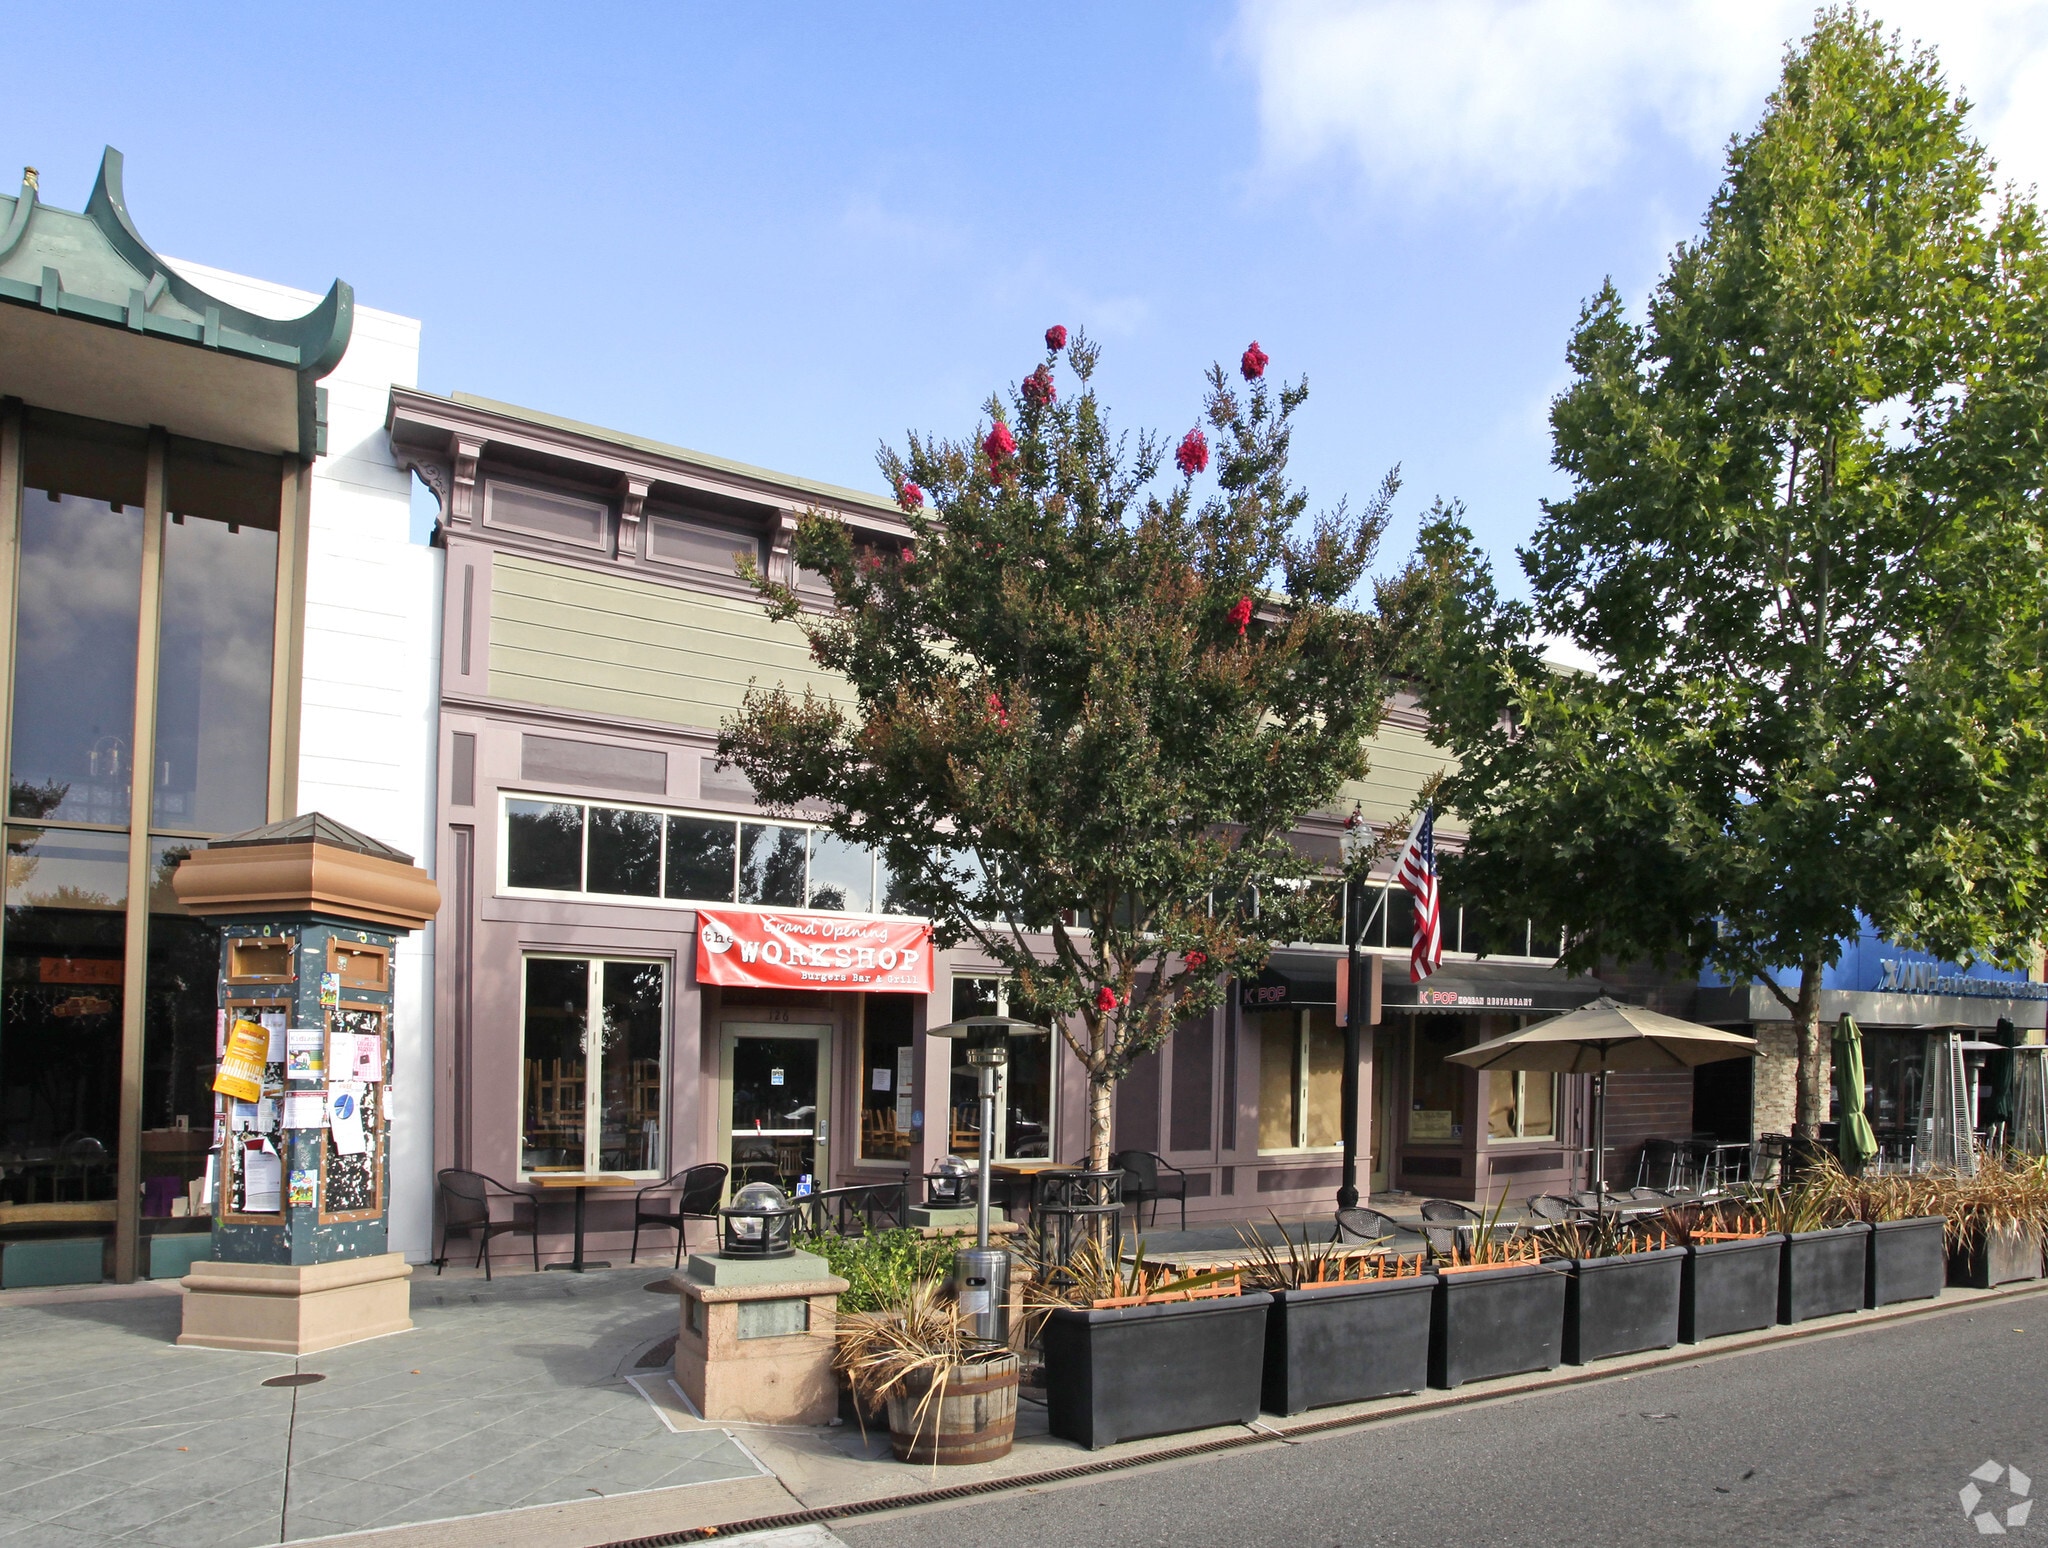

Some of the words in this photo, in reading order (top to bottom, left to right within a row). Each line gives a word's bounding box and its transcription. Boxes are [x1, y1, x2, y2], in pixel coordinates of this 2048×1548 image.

[763, 919, 817, 936] Grand
[822, 921, 888, 943] Opening
[703, 929, 734, 944] the
[740, 940, 920, 971] WORKSHOP
[801, 971, 846, 983] Burgers
[851, 973, 871, 984] Bar
[875, 975, 882, 984] &
[886, 974, 918, 985] Grill
[1258, 985, 1286, 1002] POP
[1419, 990, 1429, 1005] K
[1433, 991, 1458, 1005] POP
[1458, 996, 1484, 1006] KOREAN
[1486, 997, 1533, 1007] RESTAURANT
[768, 1009, 789, 1022] 126
